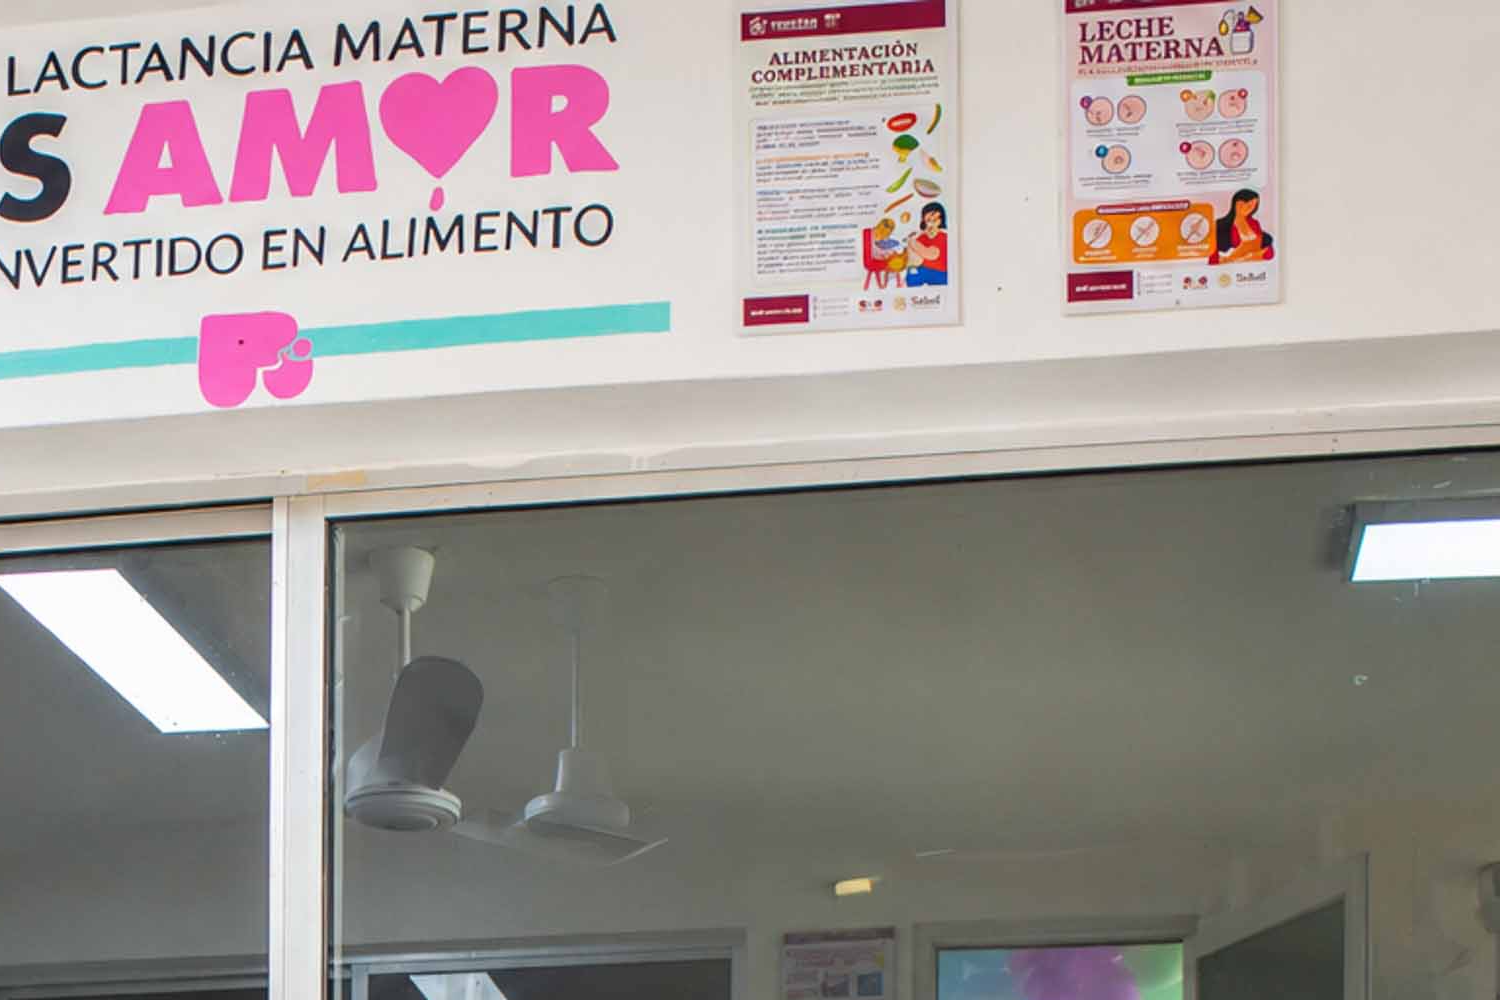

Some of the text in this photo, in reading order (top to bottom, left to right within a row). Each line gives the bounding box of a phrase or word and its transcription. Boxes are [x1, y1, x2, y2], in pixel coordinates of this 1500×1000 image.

[1079, 16, 1175, 43] LECHE
[7, 29, 314, 97] LACTANCIA
[333, 2, 618, 67] MATERNA
[769, 41, 918, 67] ALIMENTACIÓN
[1079, 36, 1224, 66] MATERNA
[751, 59, 935, 84] COMPLEMENTARIA
[262, 225, 326, 271] EN
[342, 204, 614, 263] ALIMENTO
